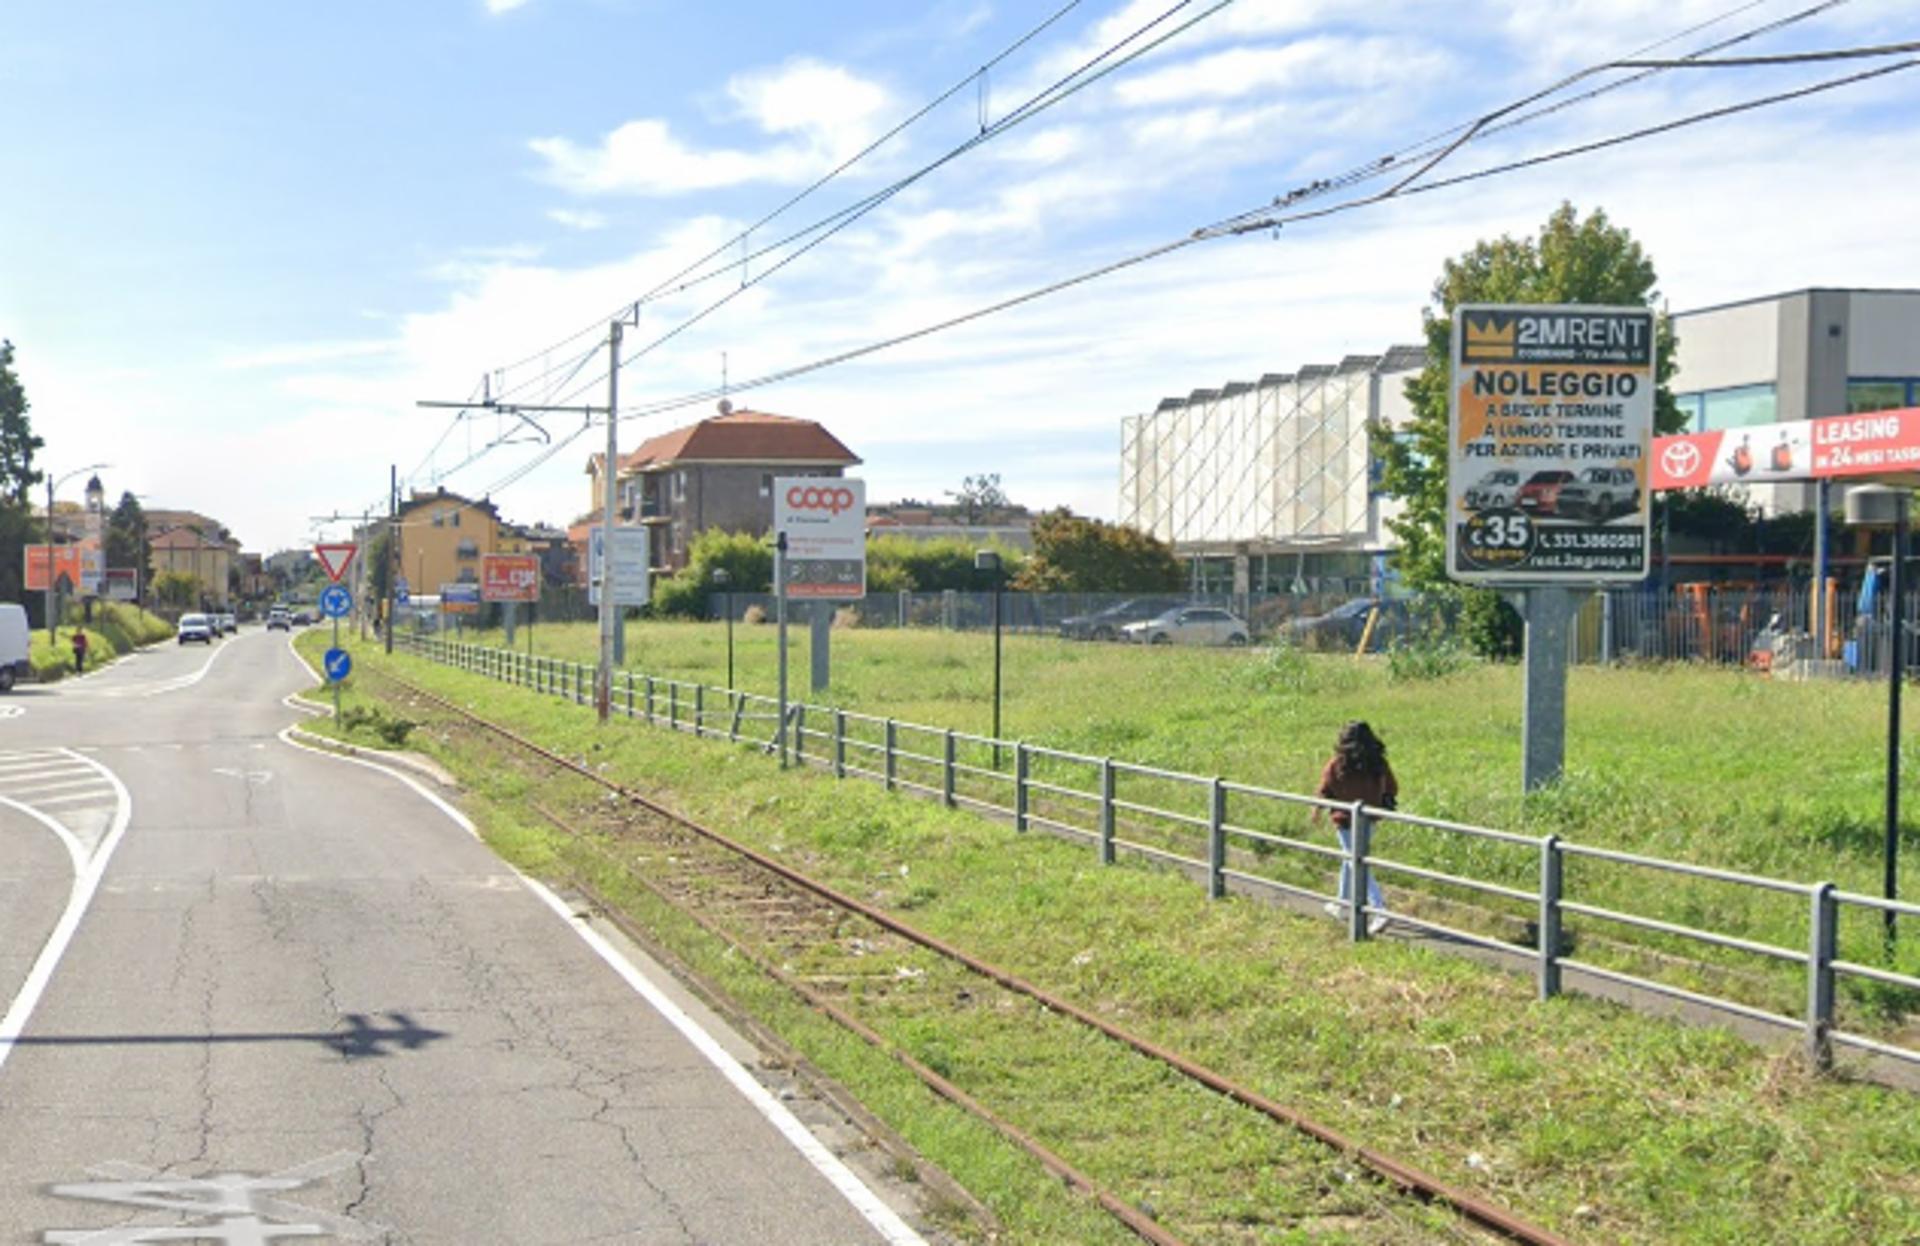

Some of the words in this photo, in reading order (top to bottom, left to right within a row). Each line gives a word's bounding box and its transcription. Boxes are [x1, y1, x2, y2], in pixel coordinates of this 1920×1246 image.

[1518, 317, 1647, 346] 2MRENT
[1474, 370, 1637, 397] NOLEGGIO
[1486, 404, 1497, 417] A
[1502, 404, 1551, 417] BREVE
[1556, 404, 1624, 418] TERMINE
[1485, 424, 1497, 437] A
[1501, 424, 1553, 438] LUNGO
[1557, 424, 1624, 438] TERMINE
[1816, 415, 1900, 445] LEASING
[1466, 444, 1495, 457] PER
[1501, 444, 1566, 458] AZIENDE
[1571, 445, 1580, 458] E
[1583, 445, 1641, 459] PRIVATI
[1831, 446, 1852, 467] 24
[786, 486, 855, 515] coop
[1485, 516, 1529, 546] 35
